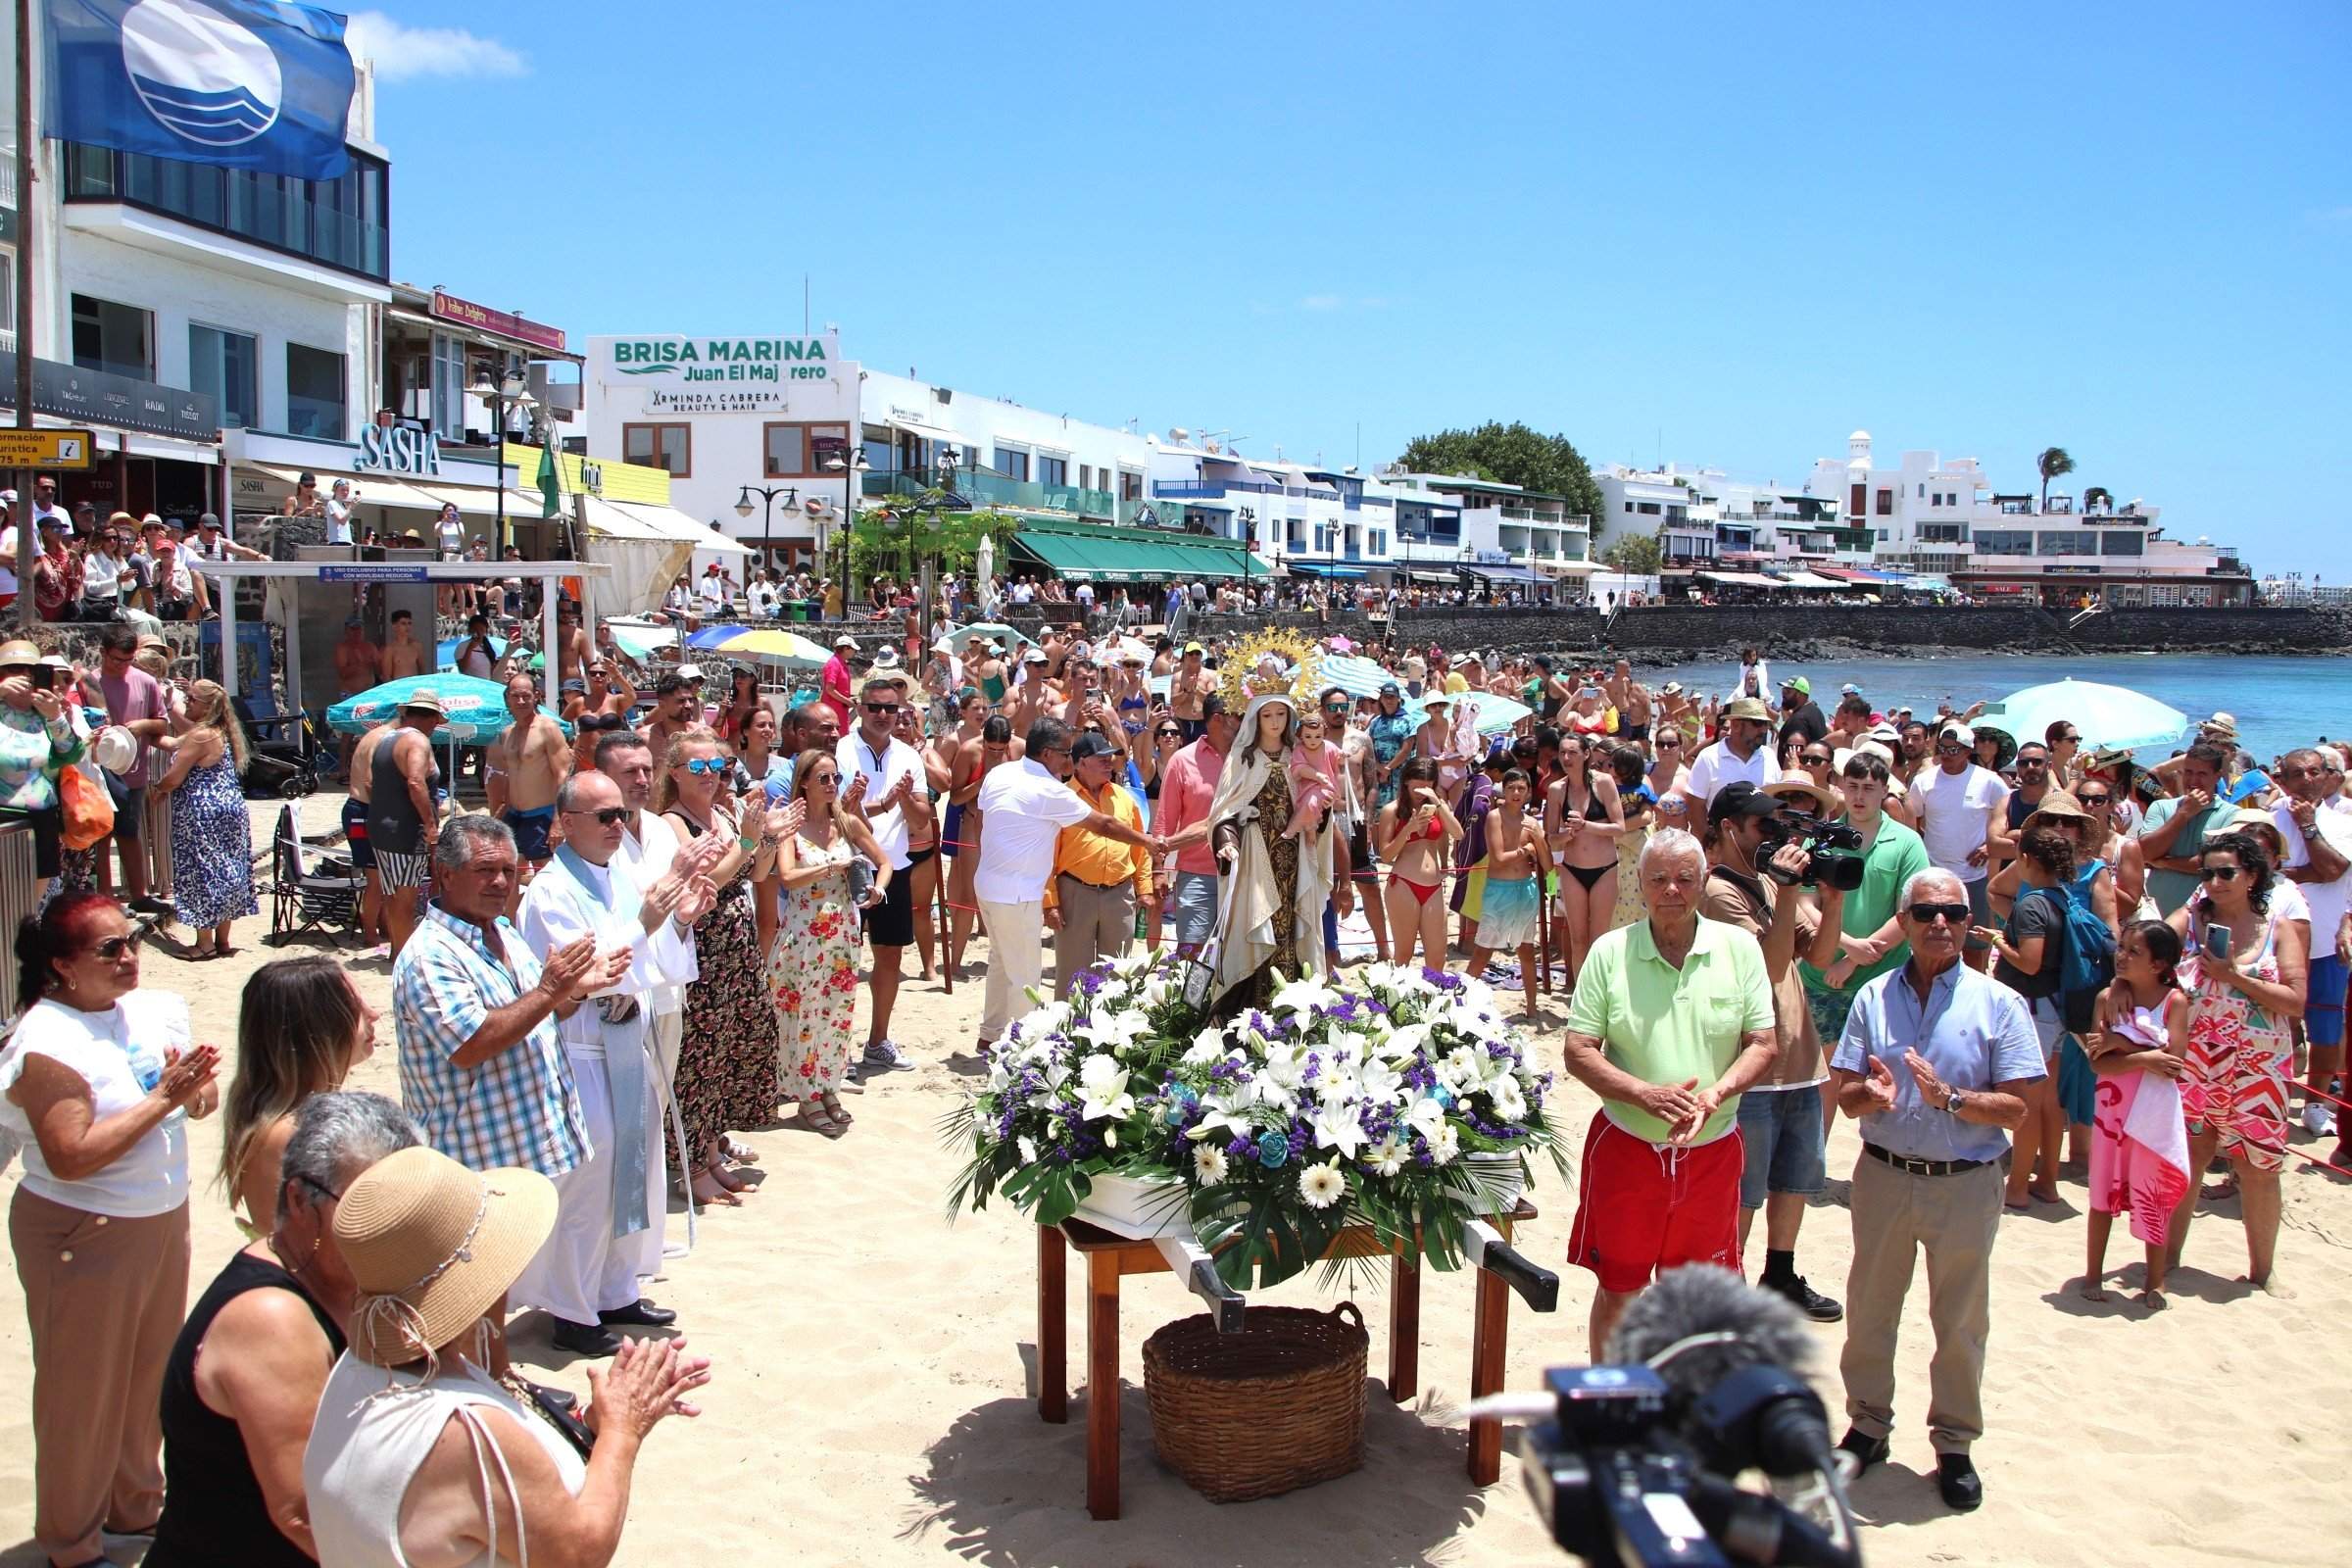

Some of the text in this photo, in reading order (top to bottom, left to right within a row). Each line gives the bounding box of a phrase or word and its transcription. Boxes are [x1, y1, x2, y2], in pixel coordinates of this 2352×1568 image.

[614, 340, 826, 363] BRISA MARINA
[684, 366, 724, 381] Juan
[728, 365, 745, 380] El
[719, 392, 780, 403] CABRERA
[145, 399, 166, 413] RADO
[180, 410, 200, 421] TISSOT
[354, 422, 443, 475] SASHA
[240, 479, 266, 493] SASHA
